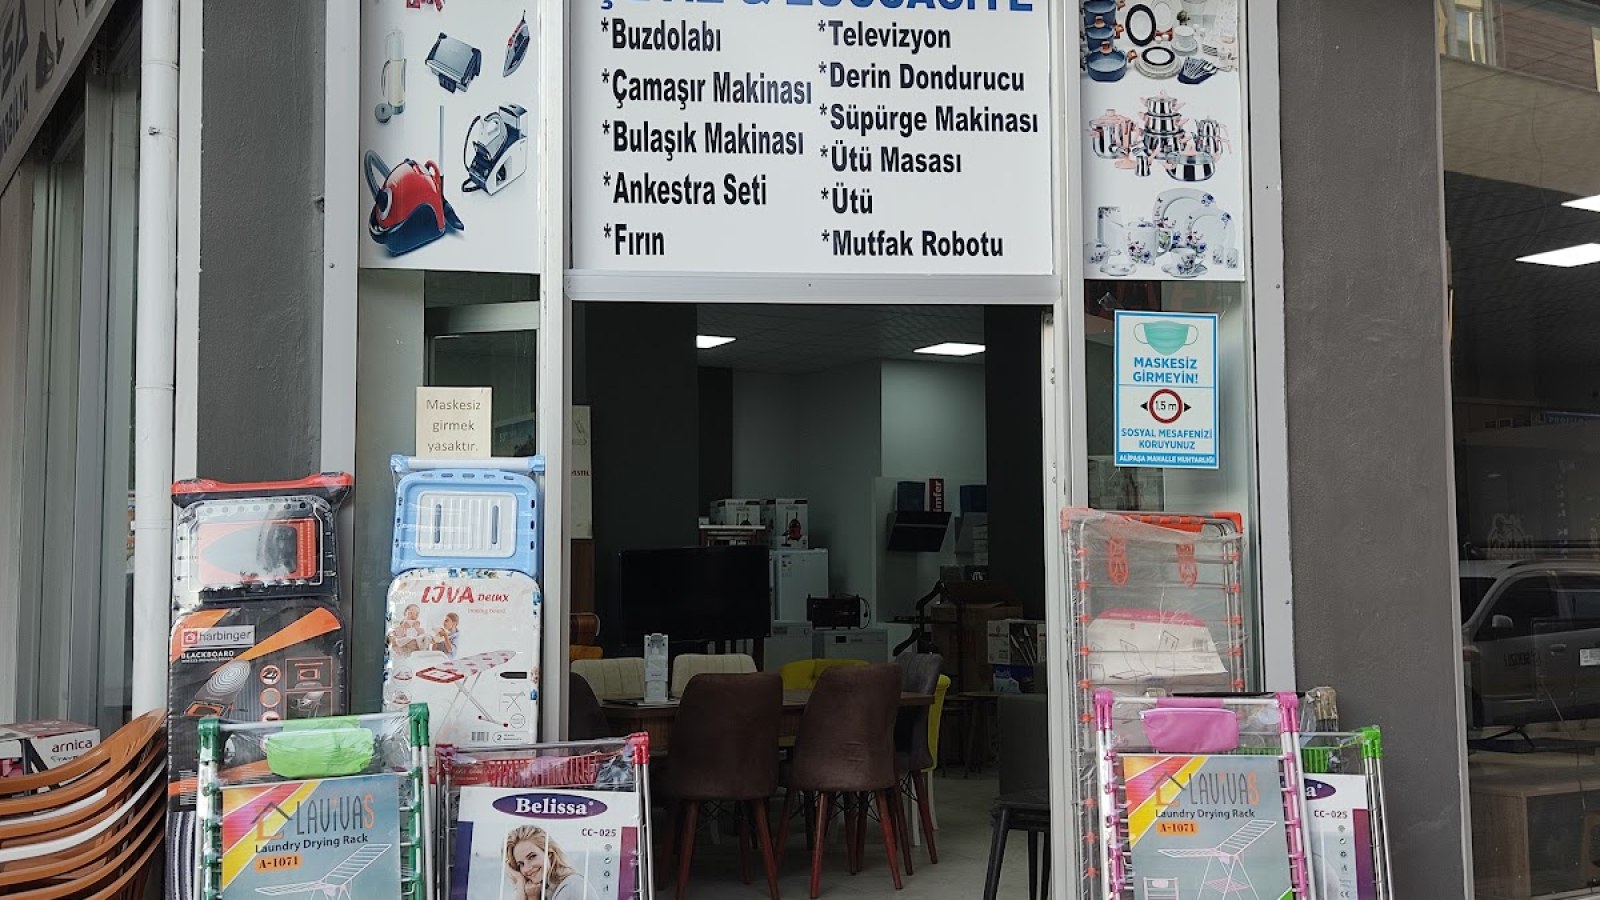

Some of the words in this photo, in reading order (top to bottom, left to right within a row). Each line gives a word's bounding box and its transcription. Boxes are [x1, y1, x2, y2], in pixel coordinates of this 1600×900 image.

[612, 18, 721, 51] Buzdolabı
[828, 20, 951, 54] Televizyon
[830, 62, 891, 89] Derin
[899, 63, 1024, 91] Dondurucu
[612, 68, 706, 110] Çamaşır
[713, 71, 812, 105] Makinası
[830, 103, 927, 138] Süpürge
[935, 105, 1038, 133] Makinası
[613, 121, 697, 161] Bulaşık
[704, 122, 804, 155] Makinası
[831, 140, 872, 172] Ütü
[881, 146, 962, 173] Masası
[613, 171, 716, 205] Ankestra
[723, 172, 767, 205] Seti
[832, 182, 873, 214] Ütü
[614, 223, 665, 255] Fırın
[833, 230, 913, 256] Mutfak
[922, 230, 1004, 256] Robotu
[1133, 356, 1198, 370] MASKESİZ
[1133, 369, 1198, 384] GİRMEYİN!
[426, 399, 481, 410] Maskesiz
[1168, 402, 1177, 410] m
[432, 419, 475, 433] girmek
[1121, 428, 1156, 438] SOSYAL
[1158, 428, 1213, 439] MESAFENİZİ
[427, 440, 479, 453] yasaktır.
[1138, 440, 1196, 450] KORUYUNUZ
[199, 630, 252, 643] harbinger
[51, 739, 93, 753] arnica
[515, 797, 588, 815] Belissa
[1156, 809, 1195, 820] Laundry
[1197, 809, 1230, 820] Drying
[1232, 808, 1256, 818] Rack
[1314, 810, 1348, 819] CC-025
[581, 828, 617, 837] CC-025
[1159, 823, 1195, 833] A-1071
[255, 841, 301, 854] Laundry
[303, 836, 340, 851] Drying
[343, 833, 369, 845] Rack
[258, 855, 299, 869] A-1071
